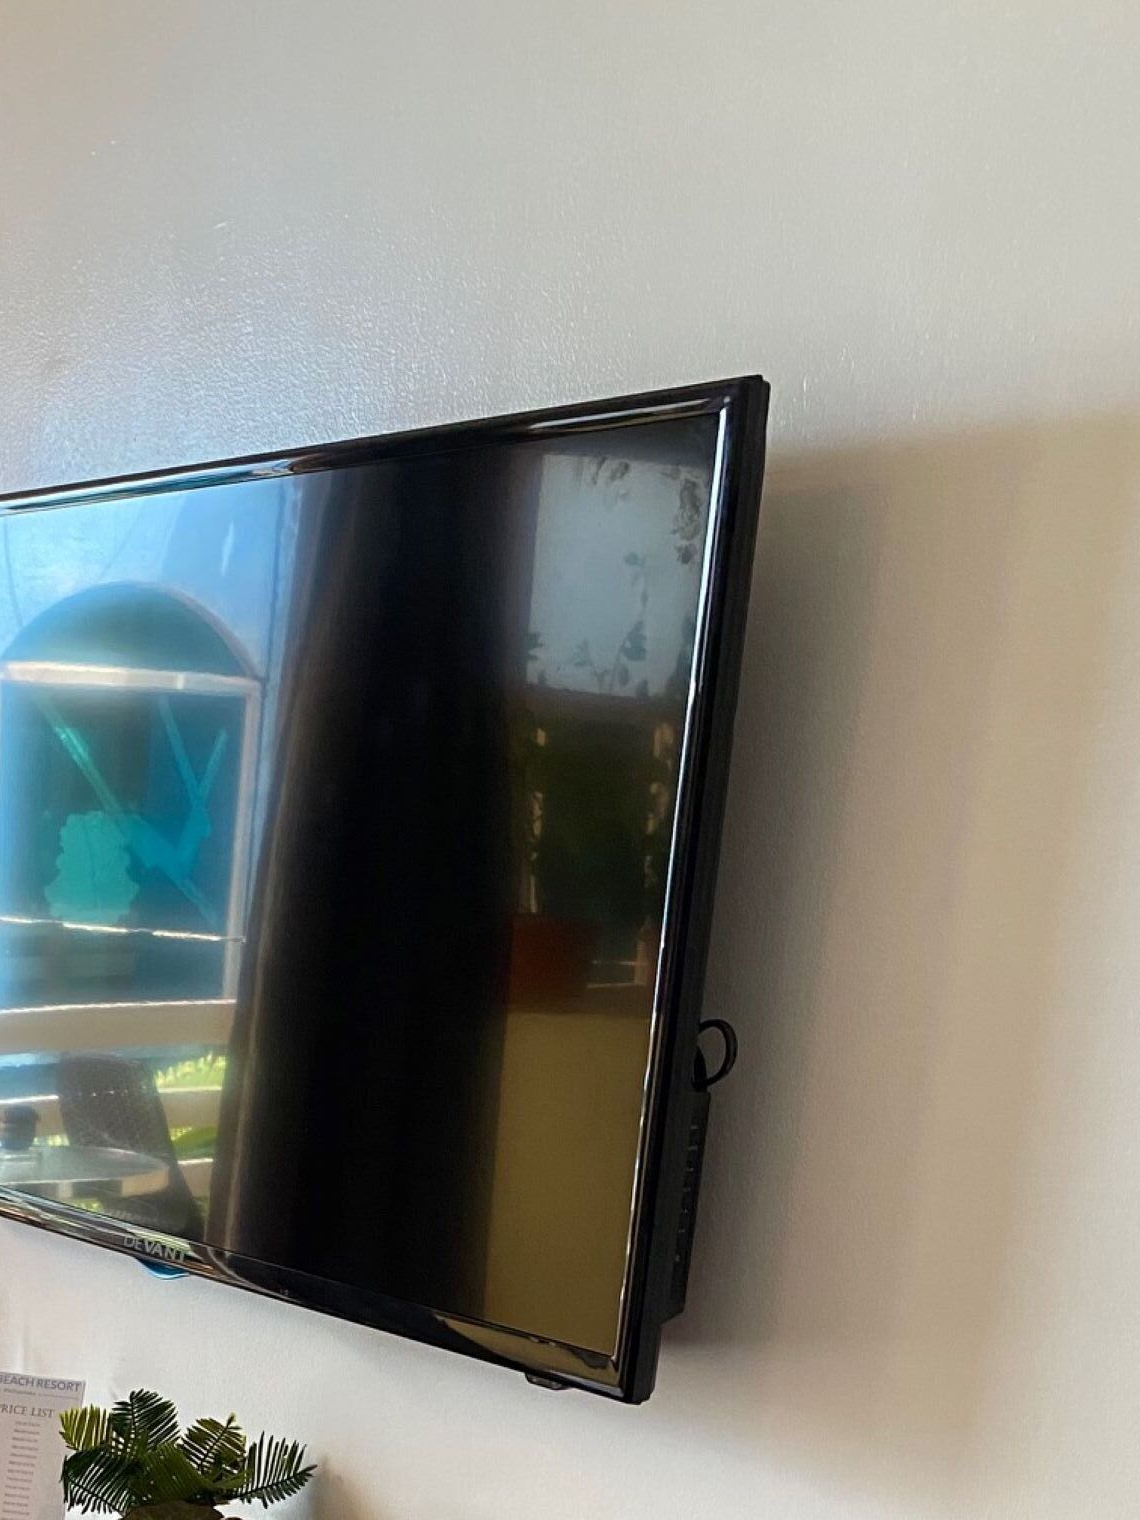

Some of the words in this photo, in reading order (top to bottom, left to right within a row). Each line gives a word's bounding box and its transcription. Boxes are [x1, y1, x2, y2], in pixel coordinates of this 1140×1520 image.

[123, 1236, 187, 1263] DEVANT
[36, 1378, 82, 1393] RESORT
[31, 1406, 55, 1419] LIST
